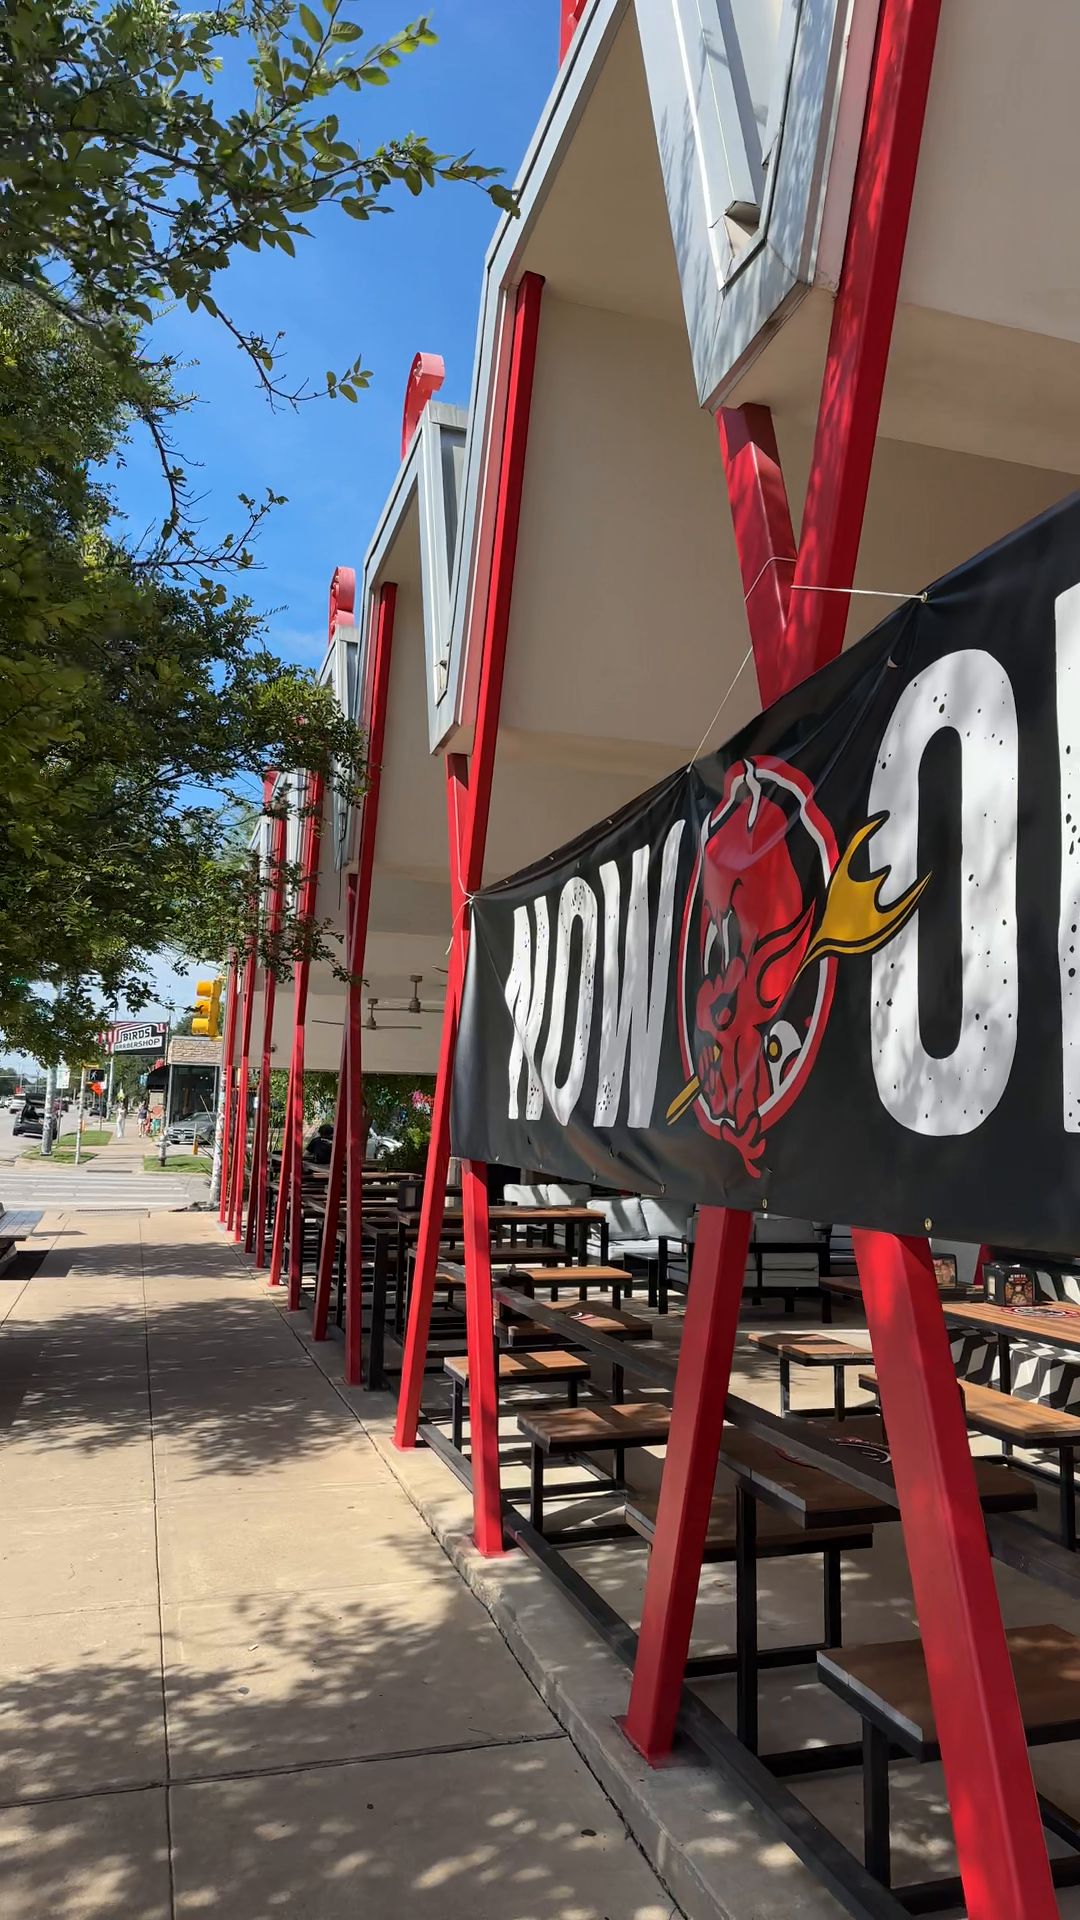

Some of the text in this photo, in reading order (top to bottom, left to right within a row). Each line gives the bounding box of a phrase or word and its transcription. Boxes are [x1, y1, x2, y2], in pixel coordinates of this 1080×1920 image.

[504, 582, 1080, 1136] NOW O
[123, 1028, 150, 1041] BIRDS
